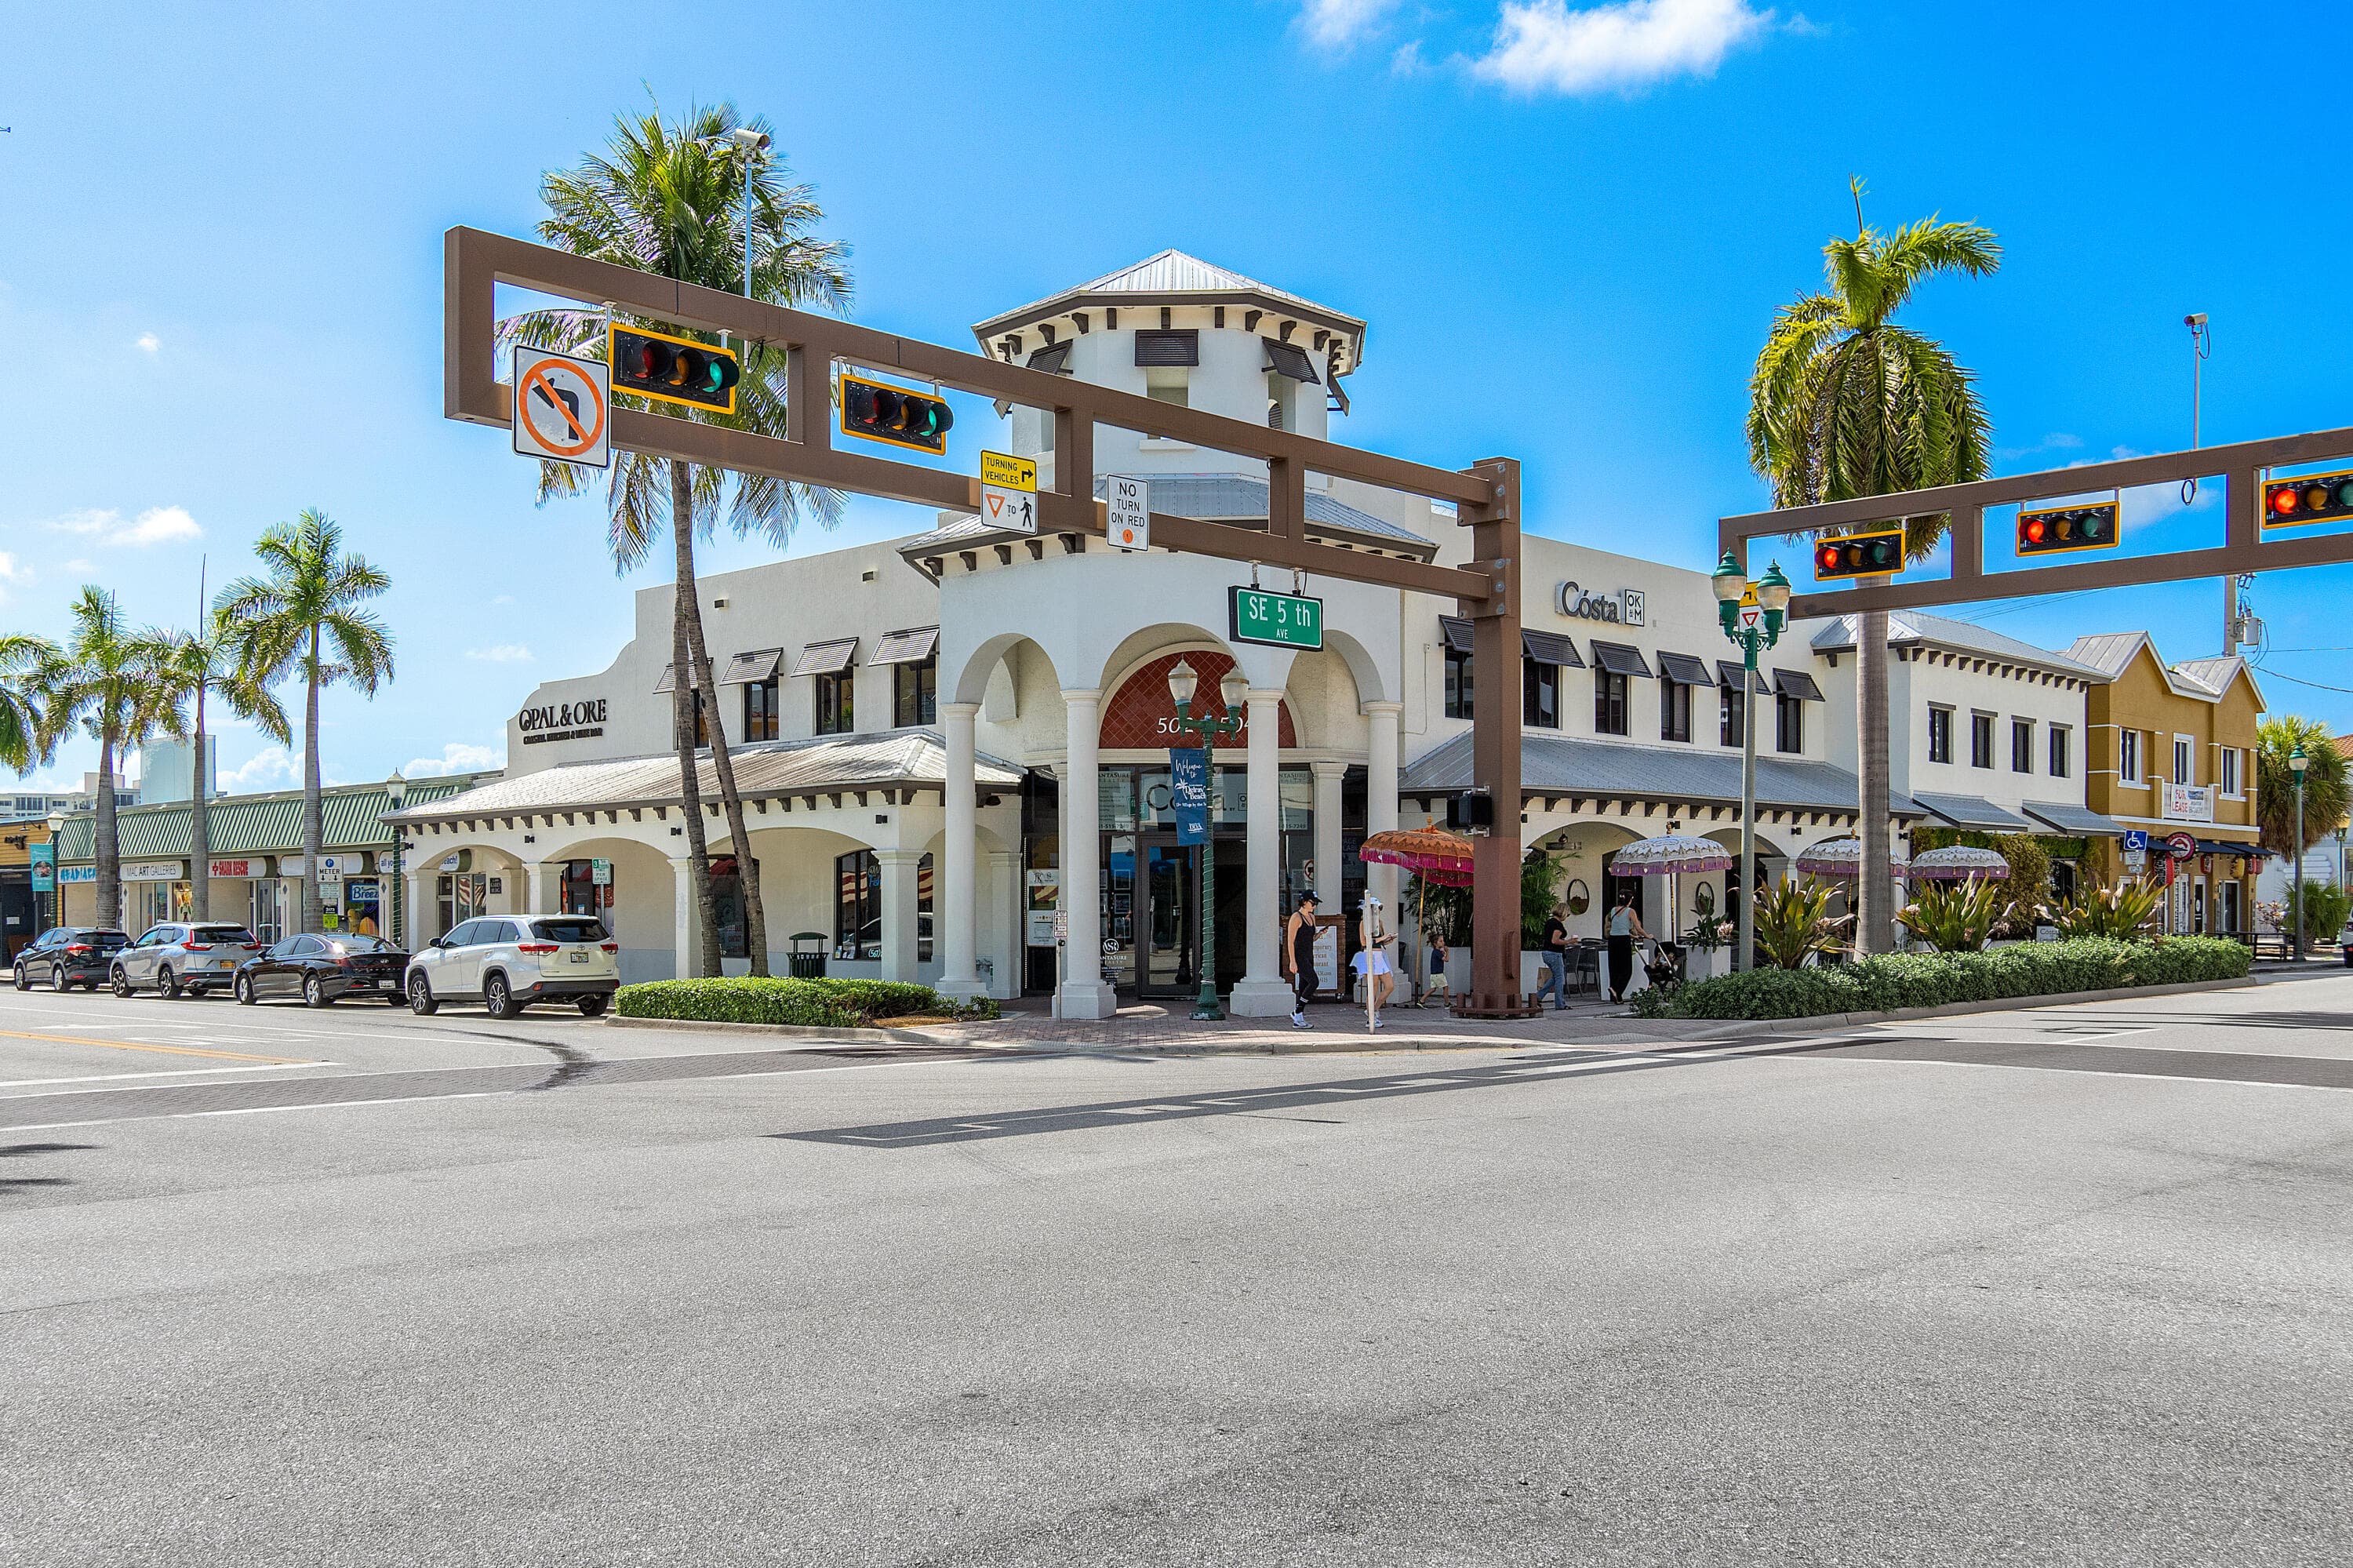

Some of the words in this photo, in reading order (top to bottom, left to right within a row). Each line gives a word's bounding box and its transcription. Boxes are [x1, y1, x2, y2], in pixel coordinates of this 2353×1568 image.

[985, 457, 1018, 471] TURNING
[985, 470, 1019, 485] VEHICLES
[1119, 482, 1136, 497] NO
[1007, 504, 1016, 515] TO
[1117, 498, 1140, 512] TURN
[1111, 512, 1123, 524] ON
[1128, 515, 1145, 527] RED
[1562, 581, 1620, 624] Cósta
[1627, 595, 1642, 608] OK
[1249, 595, 1268, 621] SE
[1278, 599, 1286, 624] 5
[1295, 603, 1311, 628] th
[1275, 628, 1289, 639] AVE
[518, 705, 559, 732] OPAL
[559, 704, 573, 727] &
[573, 699, 607, 725] ORE
[1176, 759, 1202, 776] Welcome
[1184, 786, 1206, 795] Delray
[2172, 801, 2188, 813] LEASE
[442, 855, 458, 865] each!
[127, 866, 137, 877] MAC
[138, 866, 149, 875] ART
[151, 864, 176, 875] GALLERIES
[352, 886, 379, 899] Breez
